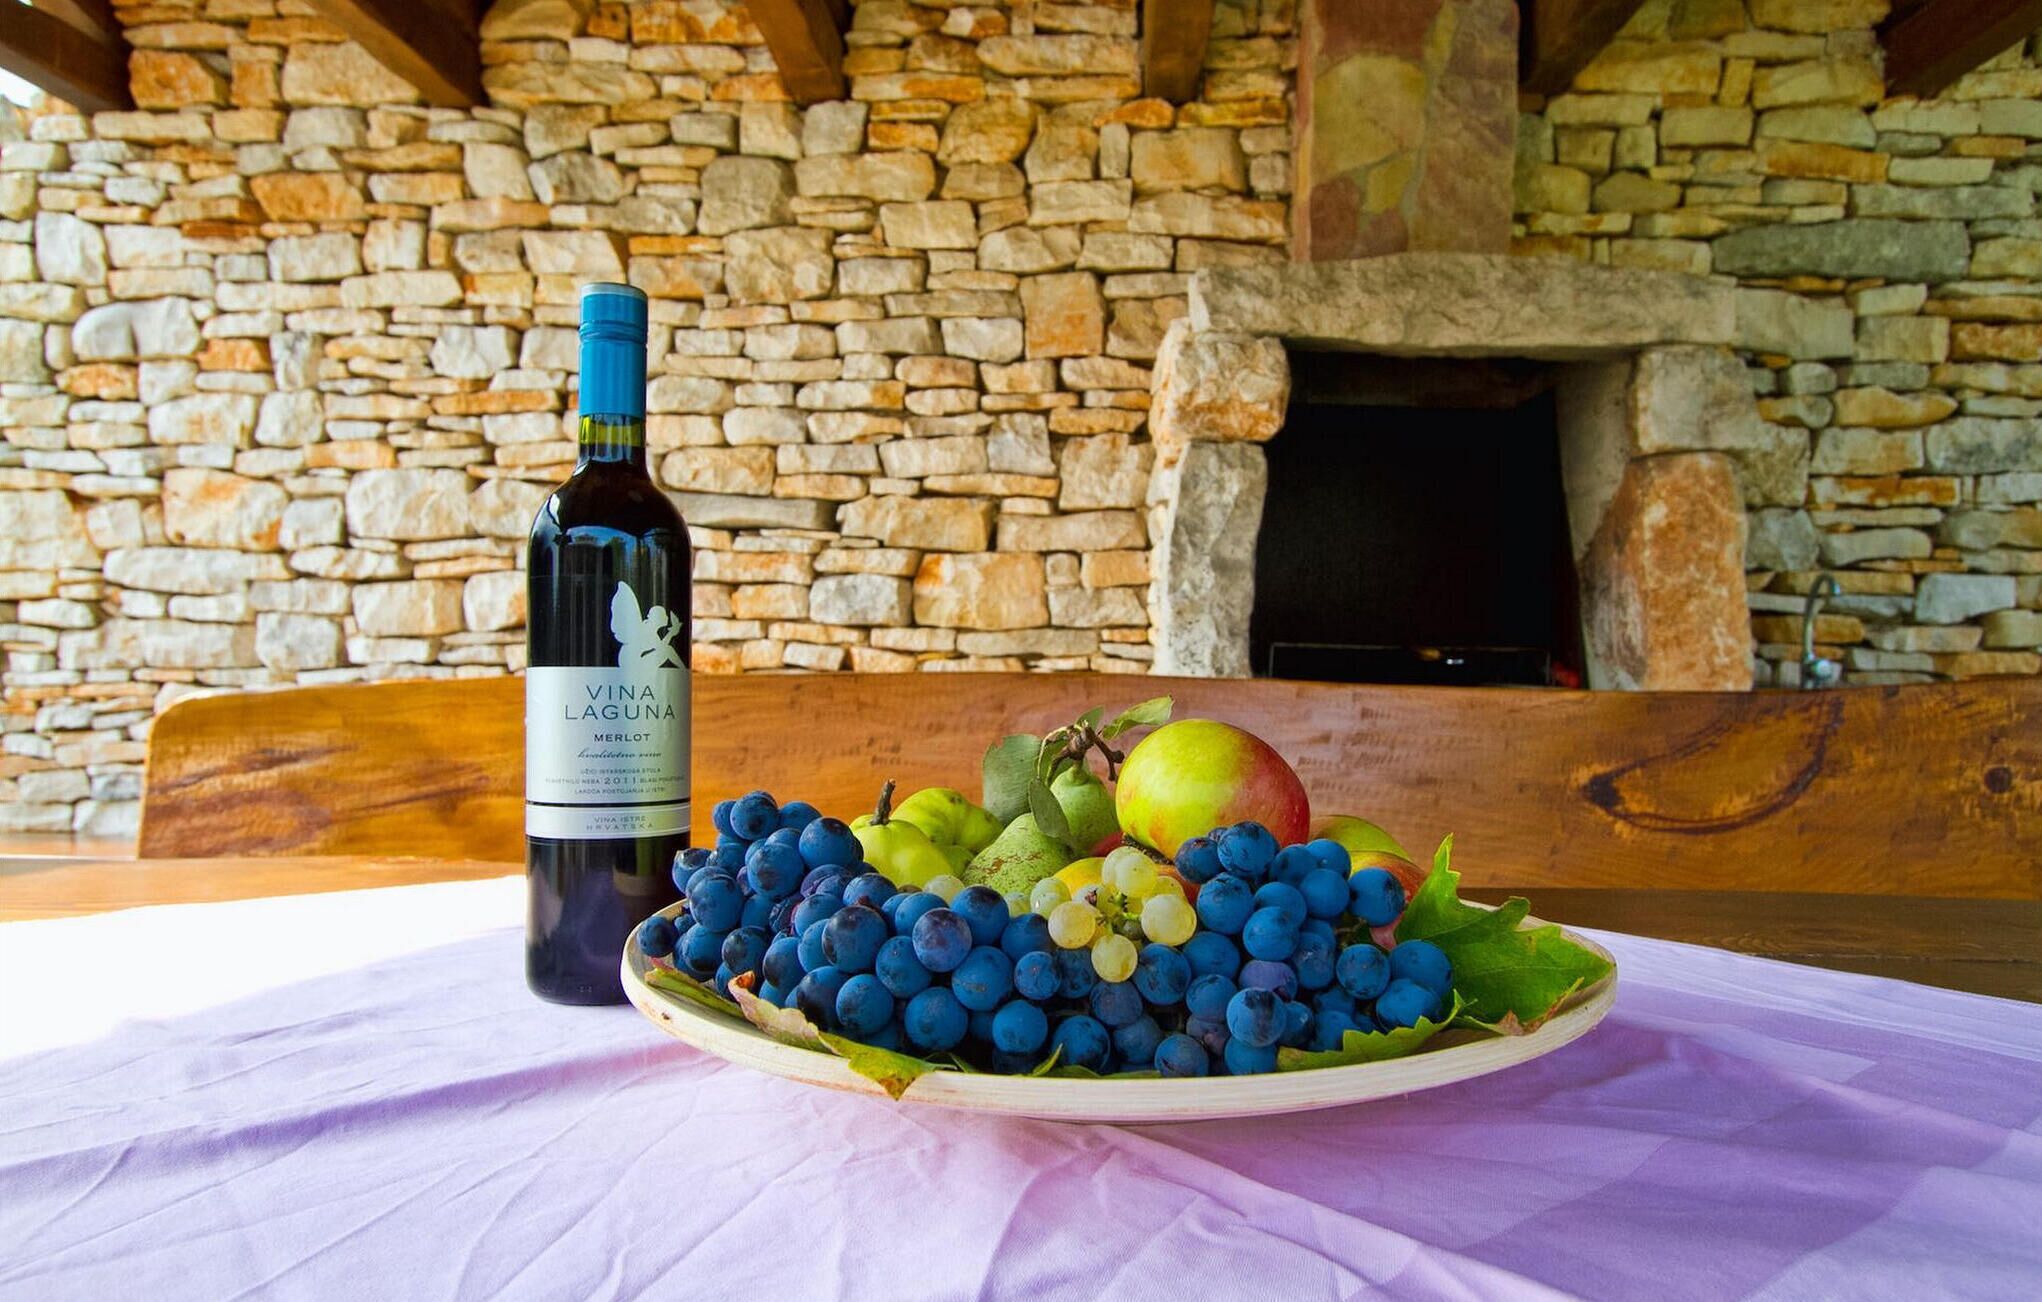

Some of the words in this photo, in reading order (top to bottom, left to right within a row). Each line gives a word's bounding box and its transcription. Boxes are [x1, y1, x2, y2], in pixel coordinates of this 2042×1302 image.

[585, 684, 655, 701] VINA
[564, 704, 676, 721] LAGUNA
[593, 732, 651, 742] MERLOT
[603, 776, 636, 785] 2011
